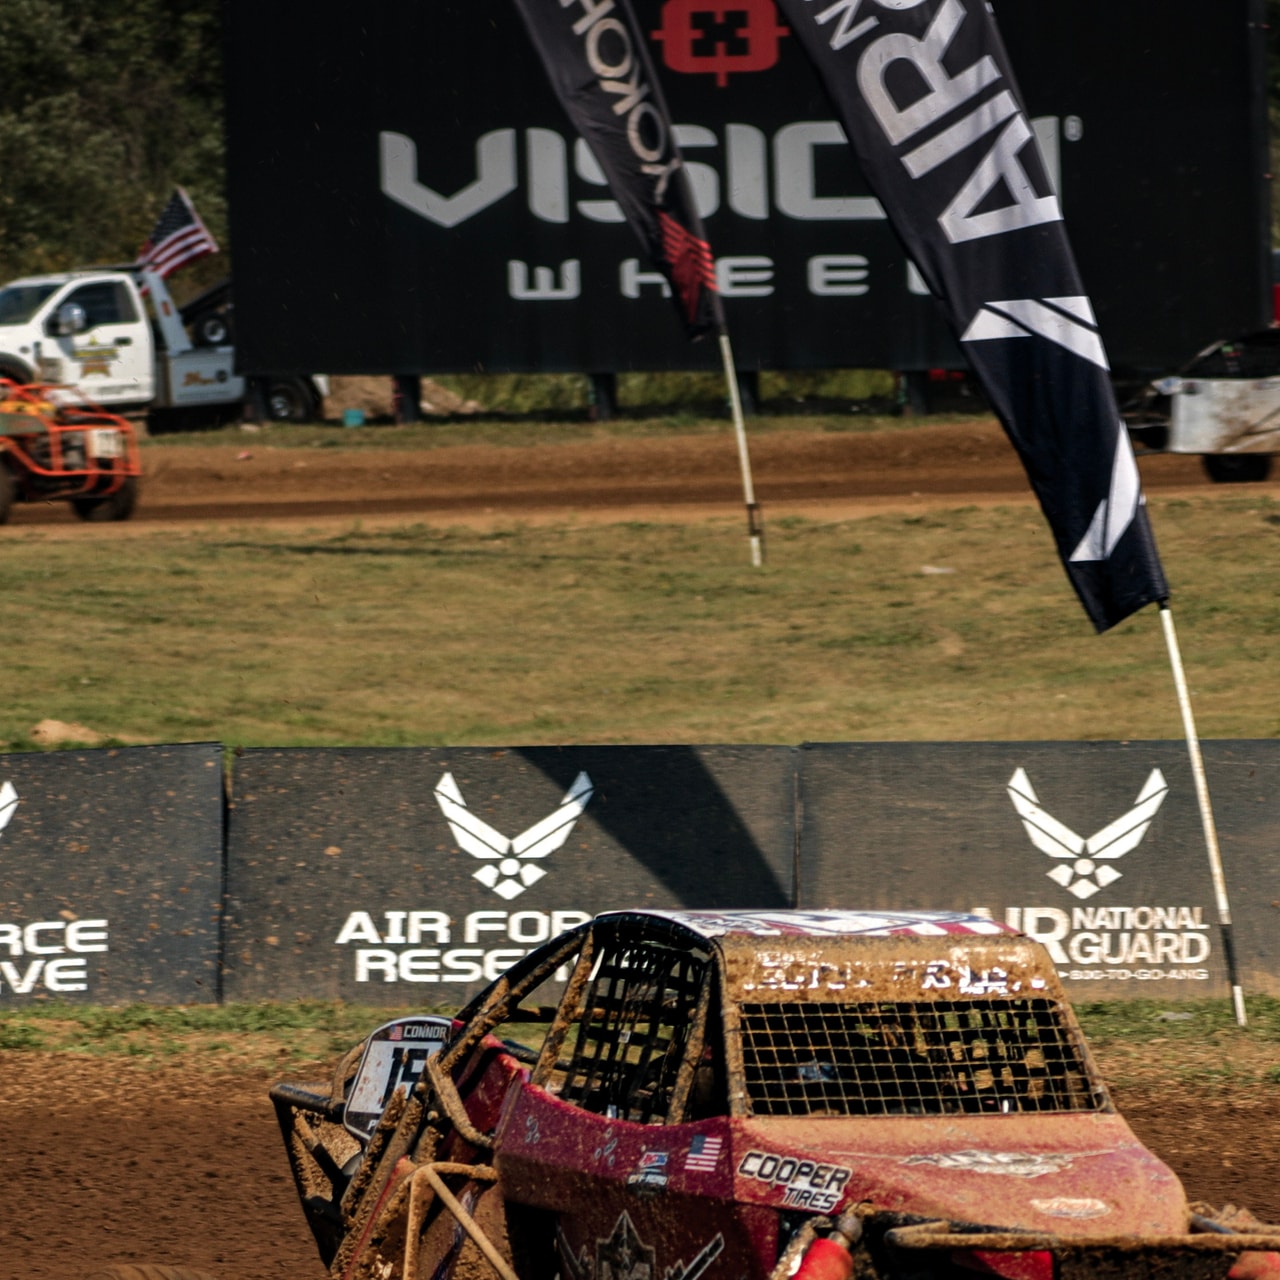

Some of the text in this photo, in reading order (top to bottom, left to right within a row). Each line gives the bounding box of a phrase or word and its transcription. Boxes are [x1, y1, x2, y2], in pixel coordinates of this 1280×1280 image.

[856, 0, 1064, 244] AIR
[379, 116, 1062, 229] VISIO
[334, 910, 452, 944] AIR
[1071, 906, 1211, 930] NATIONAL
[1069, 932, 1212, 965] GUARD
[403, 1025, 447, 1039] CONNOR
[739, 1152, 852, 1192] COOPER
[783, 1187, 840, 1211] TIRES
